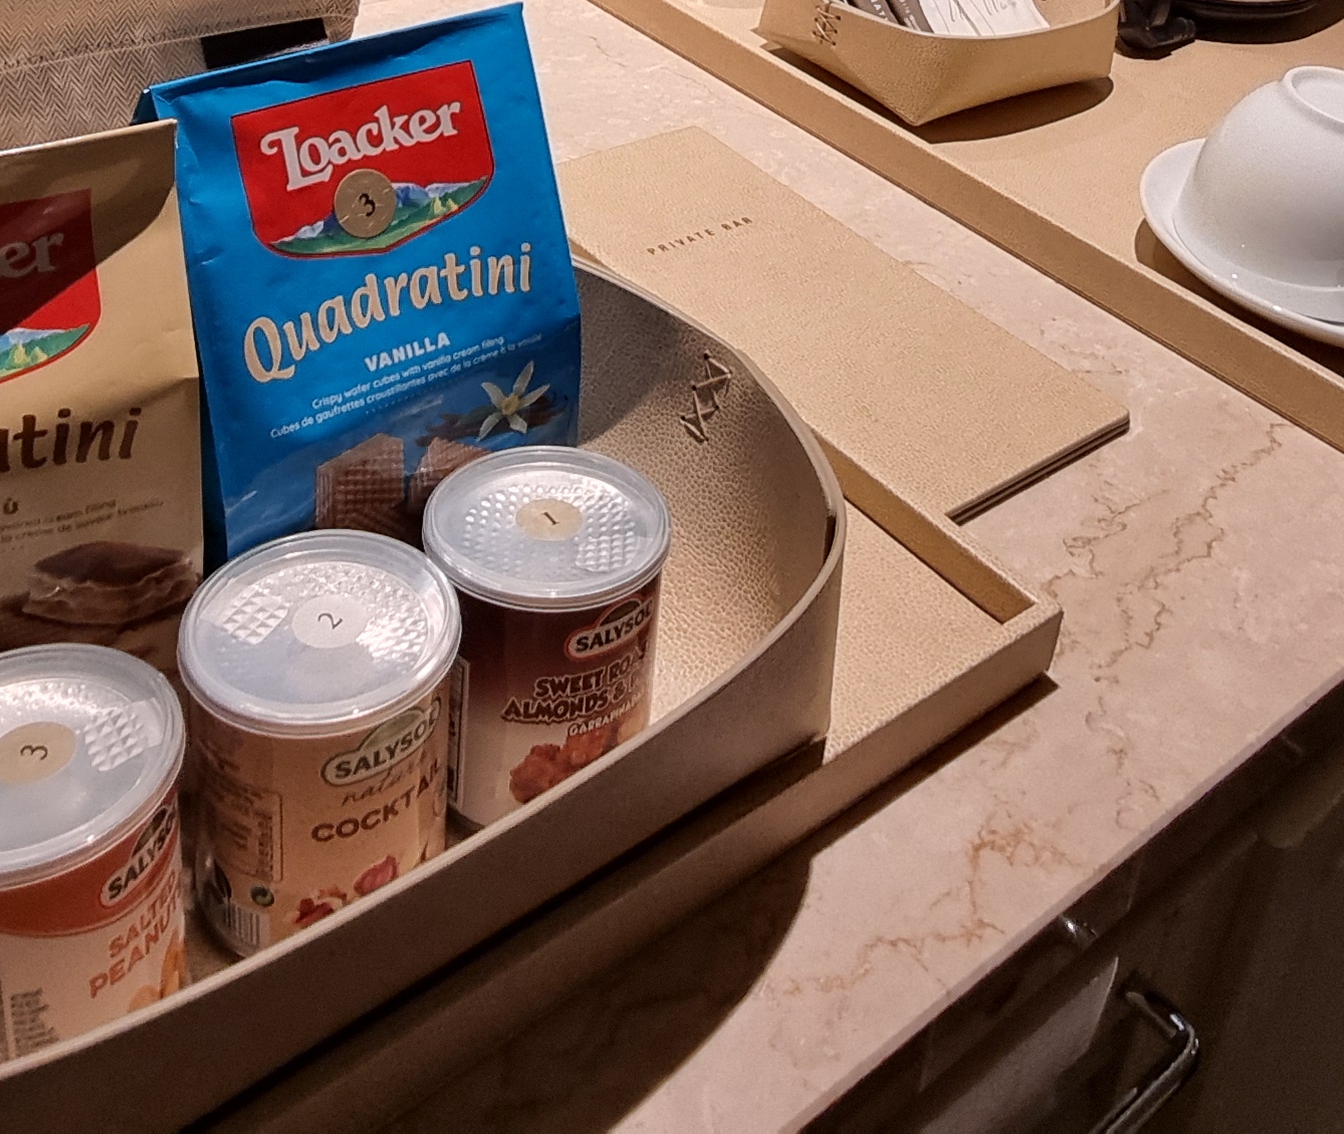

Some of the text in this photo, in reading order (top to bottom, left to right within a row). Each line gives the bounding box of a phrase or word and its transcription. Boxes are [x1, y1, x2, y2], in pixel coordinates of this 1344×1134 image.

[259, 99, 463, 193] Loacker
[358, 192, 377, 218] 3
[646, 216, 753, 256] PRIVATE BAR
[243, 242, 533, 384] Quadratini
[364, 332, 451, 372] VANILLA
[312, 391, 343, 410] Crispy
[344, 382, 371, 398] wafer
[372, 371, 401, 388] cubes
[403, 363, 421, 378] with
[421, 354, 451, 372] vanilla
[452, 345, 480, 361] cream
[270, 421, 300, 438] Cubes
[301, 414, 314, 427] de
[315, 398, 365, 424] gaufrettes
[317, 610, 343, 630] 2
[575, 600, 653, 653] SALYSOL
[502, 688, 610, 724] ALMONDS
[611, 679, 628, 703] &
[533, 666, 606, 699] SWEET
[19, 743, 49, 761] 3
[334, 707, 436, 780] SALYSOL
